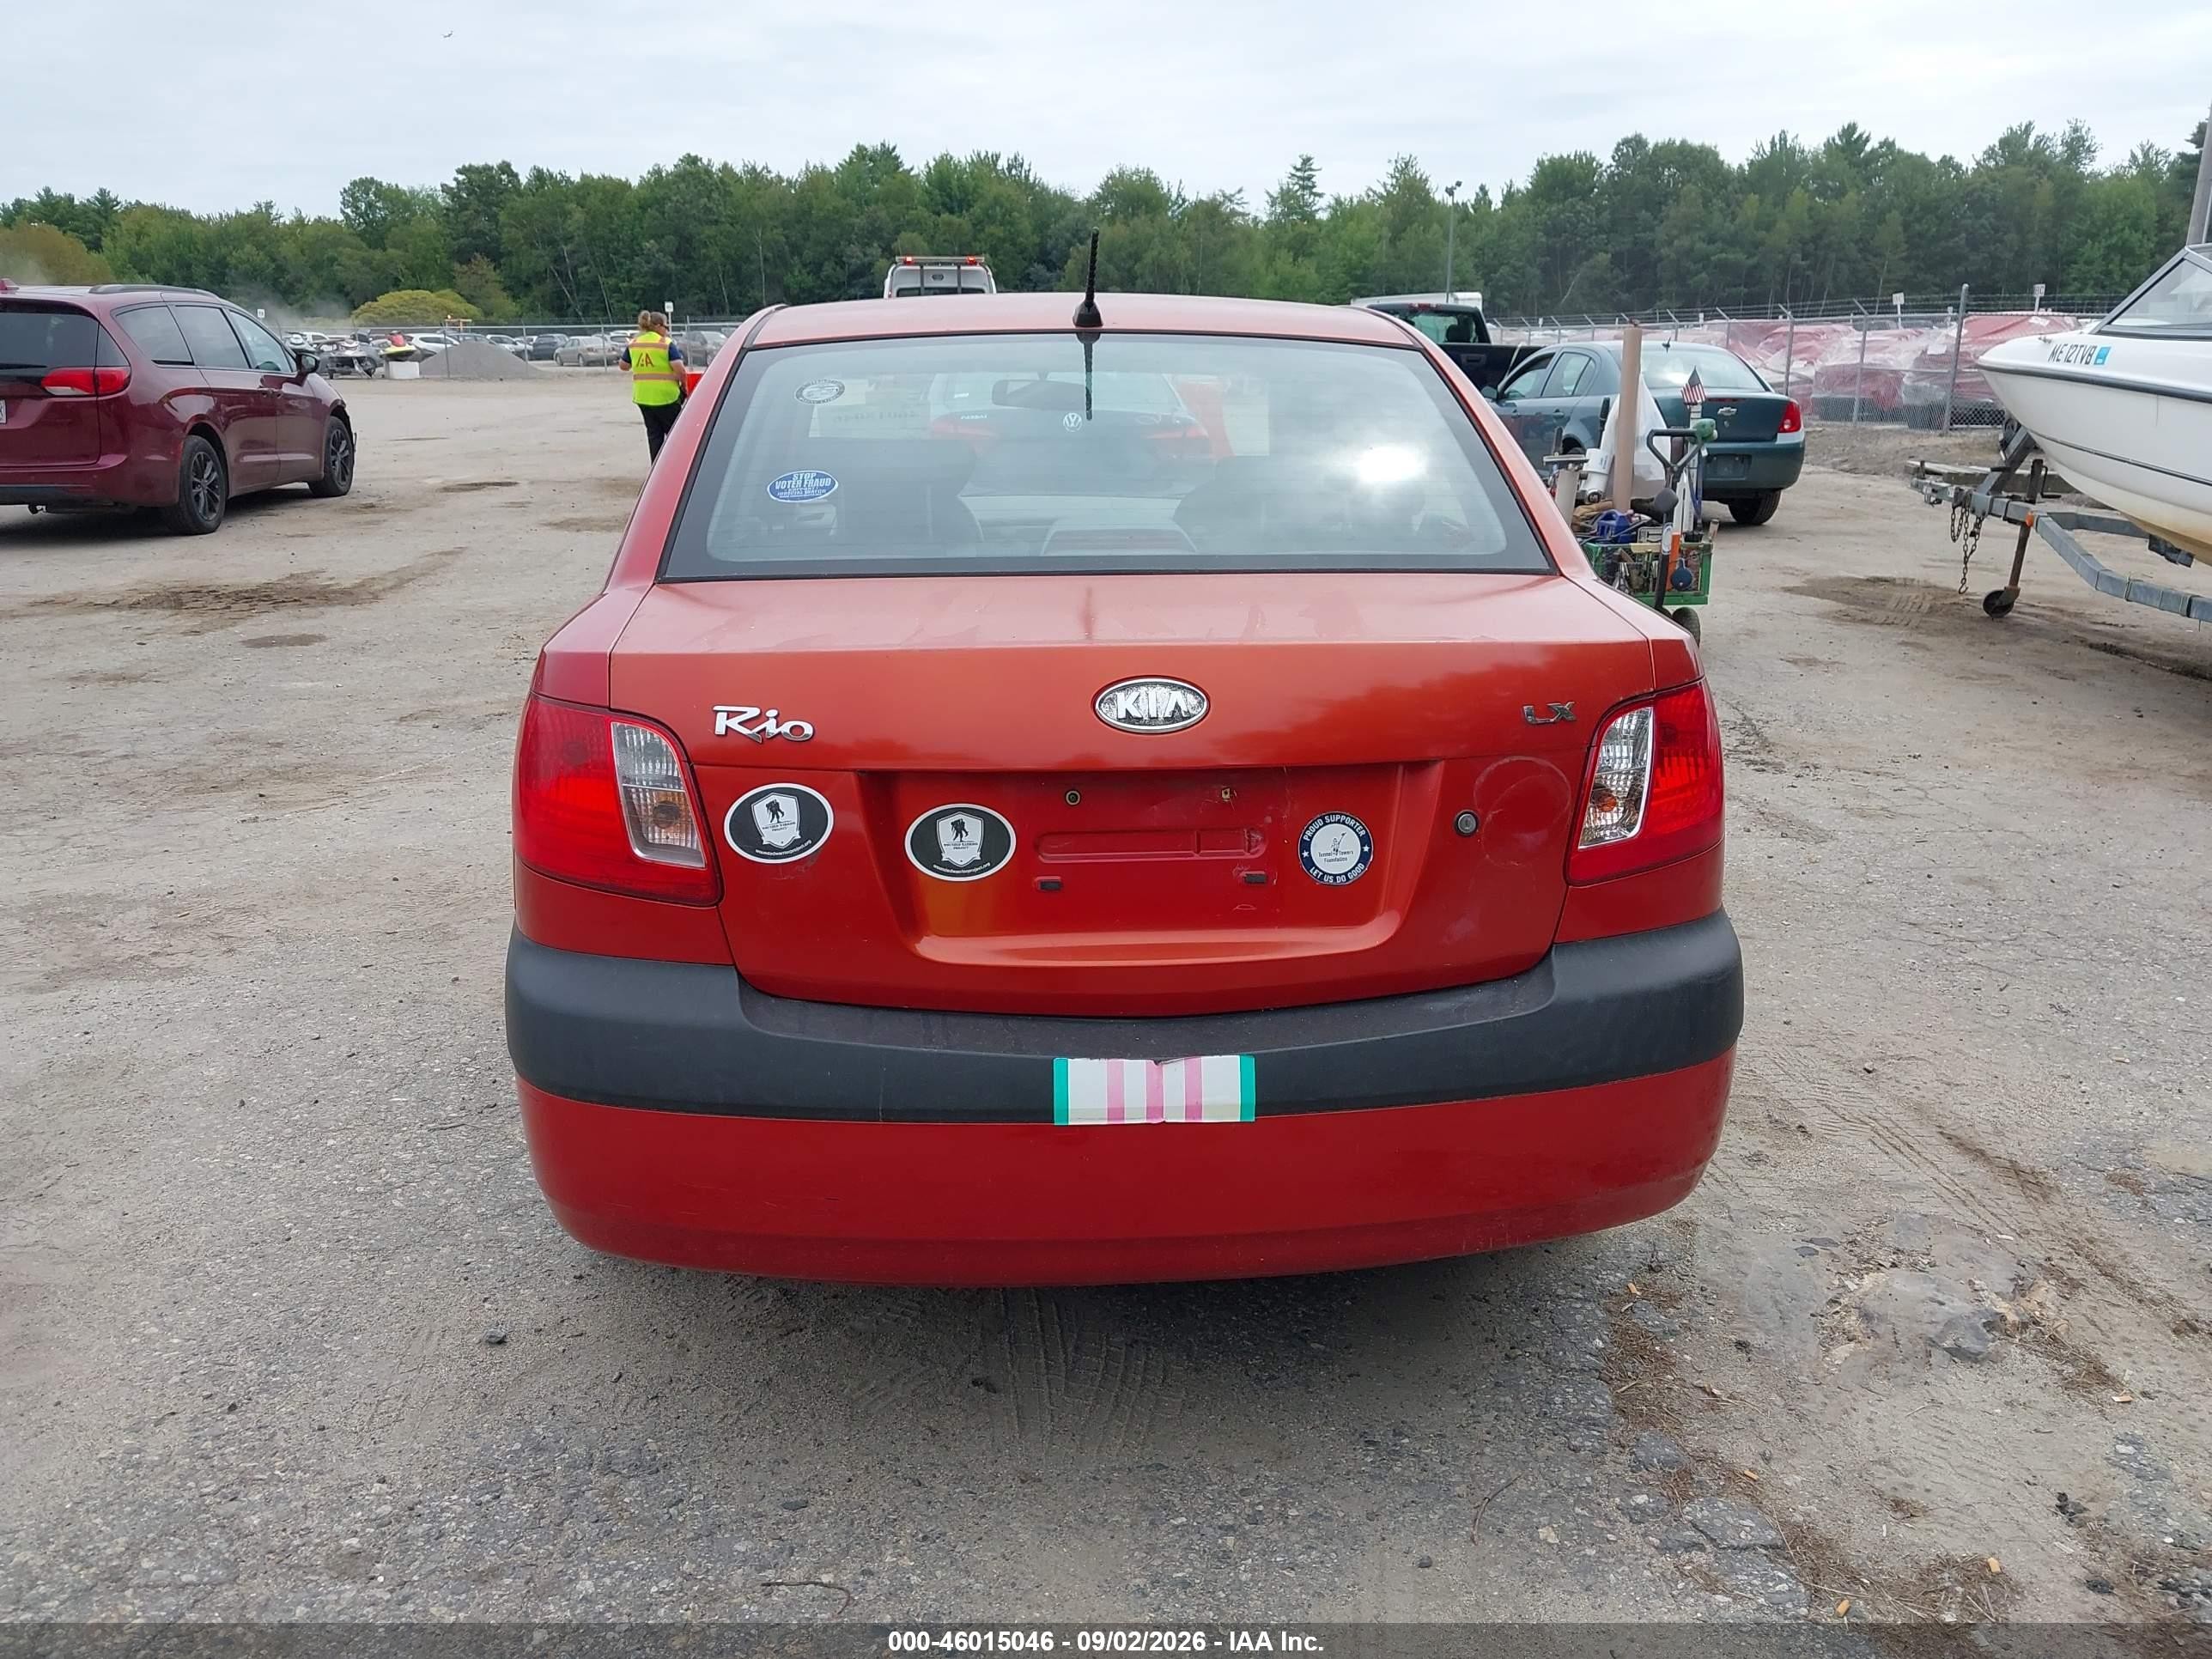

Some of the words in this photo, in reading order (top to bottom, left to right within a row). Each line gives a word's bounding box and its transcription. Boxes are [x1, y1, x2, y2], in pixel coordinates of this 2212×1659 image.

[2048, 343, 2068, 362] ME
[775, 480, 802, 489] VOTER
[803, 477, 832, 488] FRAUD
[792, 472, 817, 481] STOP
[1116, 690, 1191, 719] KIA
[1522, 701, 1577, 725] LX
[712, 705, 814, 744] Rio
[1303, 818, 1323, 842] PROUD
[1324, 814, 1366, 837] SUPPORTER
[1310, 866, 1322, 879] LET
[1336, 874, 1346, 884] DO
[1347, 863, 1365, 879] GOOD
